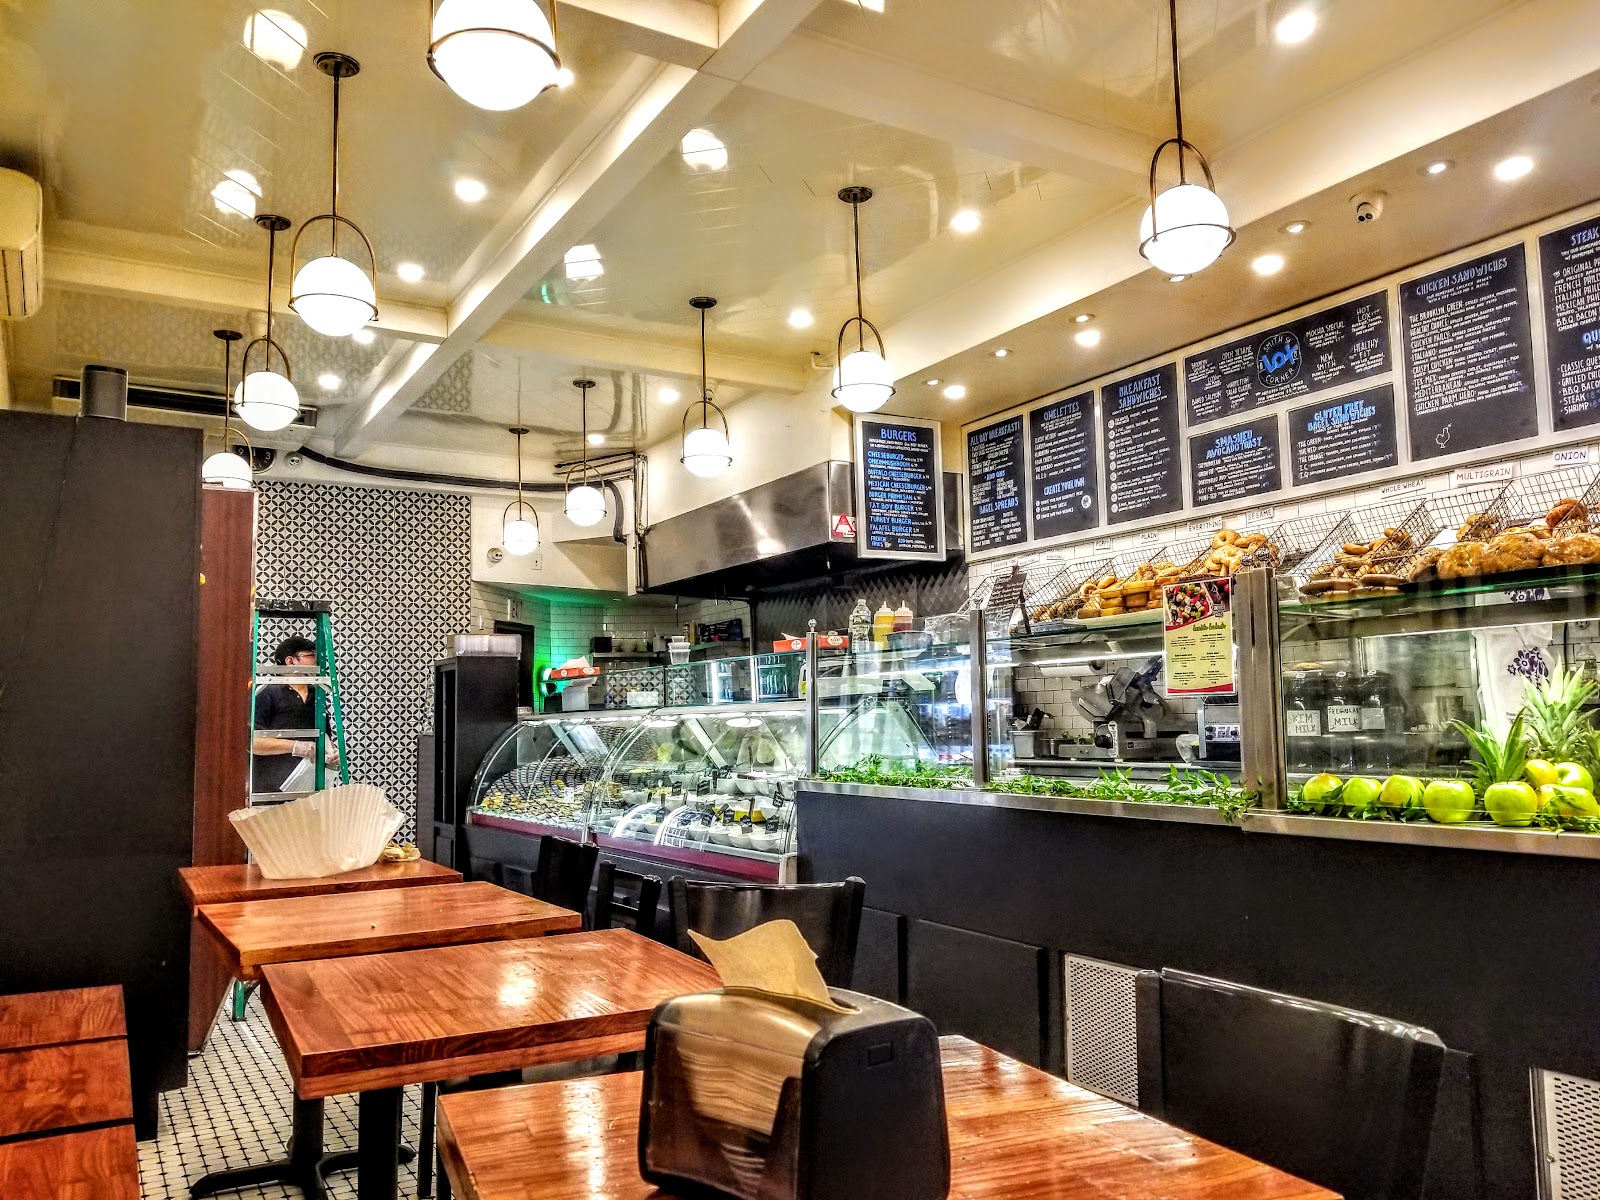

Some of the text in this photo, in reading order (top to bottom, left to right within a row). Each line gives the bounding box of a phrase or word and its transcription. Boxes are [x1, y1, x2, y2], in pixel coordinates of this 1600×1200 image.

[1572, 228, 1598, 245] STEAK
[1563, 262, 1592, 276] ORIGINAL
[1417, 258, 1507, 295] CHICKEN SANDWICHES
[1555, 273, 1600, 294] FRENCH PHILL
[1555, 289, 1581, 303] ITALIAN
[1357, 305, 1370, 315] HOT
[1556, 298, 1584, 312] MEXICAN
[1358, 312, 1370, 322] LOX
[1409, 307, 1444, 323] THE BROOKLYN
[1576, 309, 1597, 321] BACON
[1306, 327, 1325, 337] MOCHA
[1410, 324, 1429, 336] HEALTHY
[1583, 329, 1600, 343] QU
[1264, 336, 1283, 352] SMITH
[1354, 338, 1378, 352] HEALTHY
[1411, 337, 1432, 348] CHICKEN
[1222, 351, 1233, 360] OPEN
[1321, 352, 1333, 362] NEW
[1317, 360, 1336, 370] SMITH
[1413, 364, 1429, 374] CRISPY
[1561, 360, 1583, 372] CLASSIC
[1266, 368, 1294, 383] CORNER
[1562, 374, 1586, 386] GRILLED
[1119, 374, 1160, 397] BREAKFAST
[1119, 386, 1161, 409] SANDWICHES
[1205, 391, 1221, 401] SALMON
[1416, 390, 1476, 411] CHICKEN PARM HERO:
[1564, 393, 1585, 405] STEAK
[1044, 402, 1080, 421] OMELETTES
[1315, 400, 1363, 421] GLUTEN FREE
[1564, 402, 1588, 414] SHRIMP
[1308, 407, 1375, 431] BAGEL SANDWICHES
[881, 429, 916, 441] BURGERS
[1216, 430, 1252, 447] SMASHED
[1207, 437, 1262, 458] AVOCADO TOAST
[868, 451, 903, 460] CHEESEBURGER
[1554, 451, 1587, 461] ONION
[889, 471, 921, 479] CHEESEBURGER
[1457, 468, 1511, 480] MULTIGRAIN
[891, 482, 925, 490] CHEESEBURGER
[1044, 484, 1060, 495] CREATE
[1381, 480, 1424, 494] WHOLE WHEAT
[979, 497, 1018, 514] BAGEL SPREADS
[1248, 510, 1272, 520] SESAME
[1188, 520, 1221, 531] EVERYTHING
[1334, 718, 1358, 726] MILK
[1295, 724, 1316, 733] MILK
